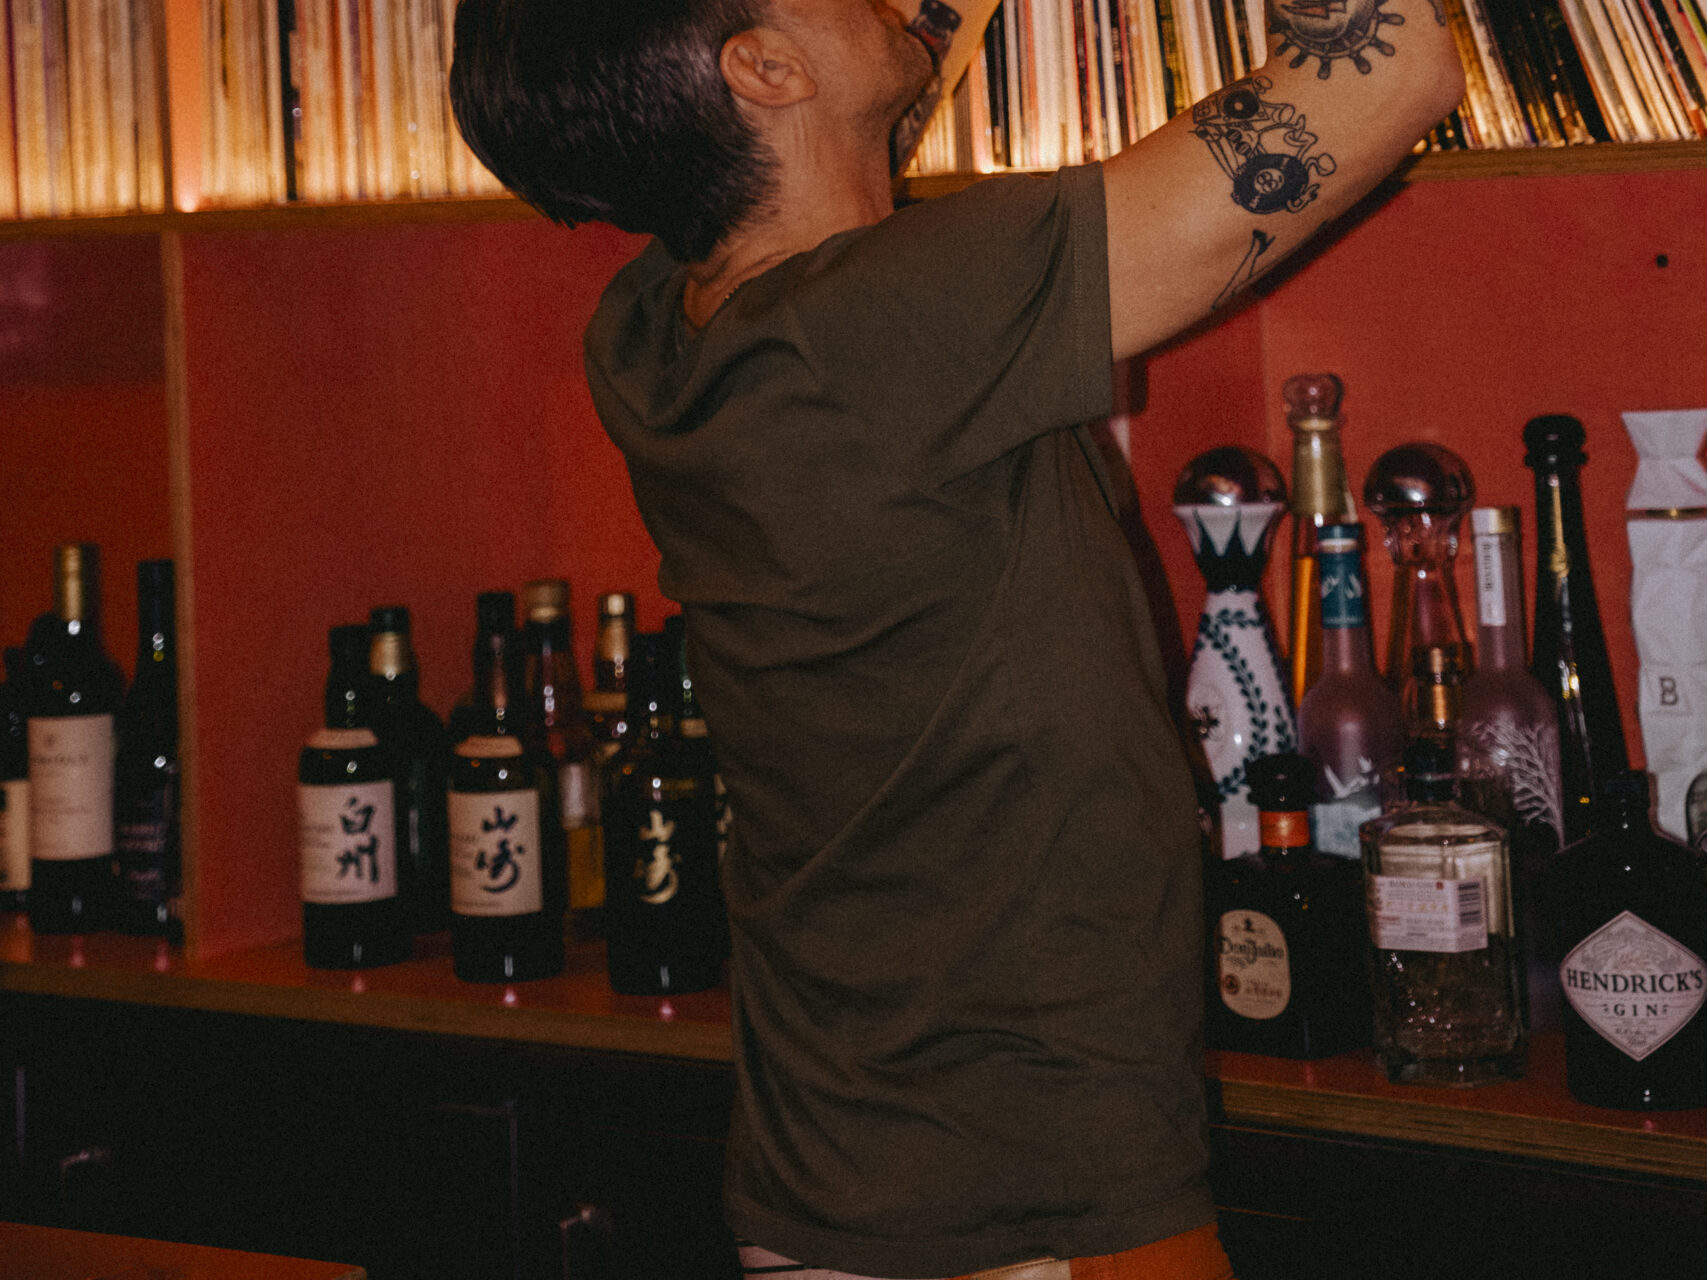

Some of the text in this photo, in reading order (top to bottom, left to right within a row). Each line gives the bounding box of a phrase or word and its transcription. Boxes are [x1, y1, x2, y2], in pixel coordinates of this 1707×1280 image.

[1659, 676, 1679, 706] B
[1566, 967, 1704, 994] HENDRICK'S
[1613, 1003, 1658, 1017] GIN
